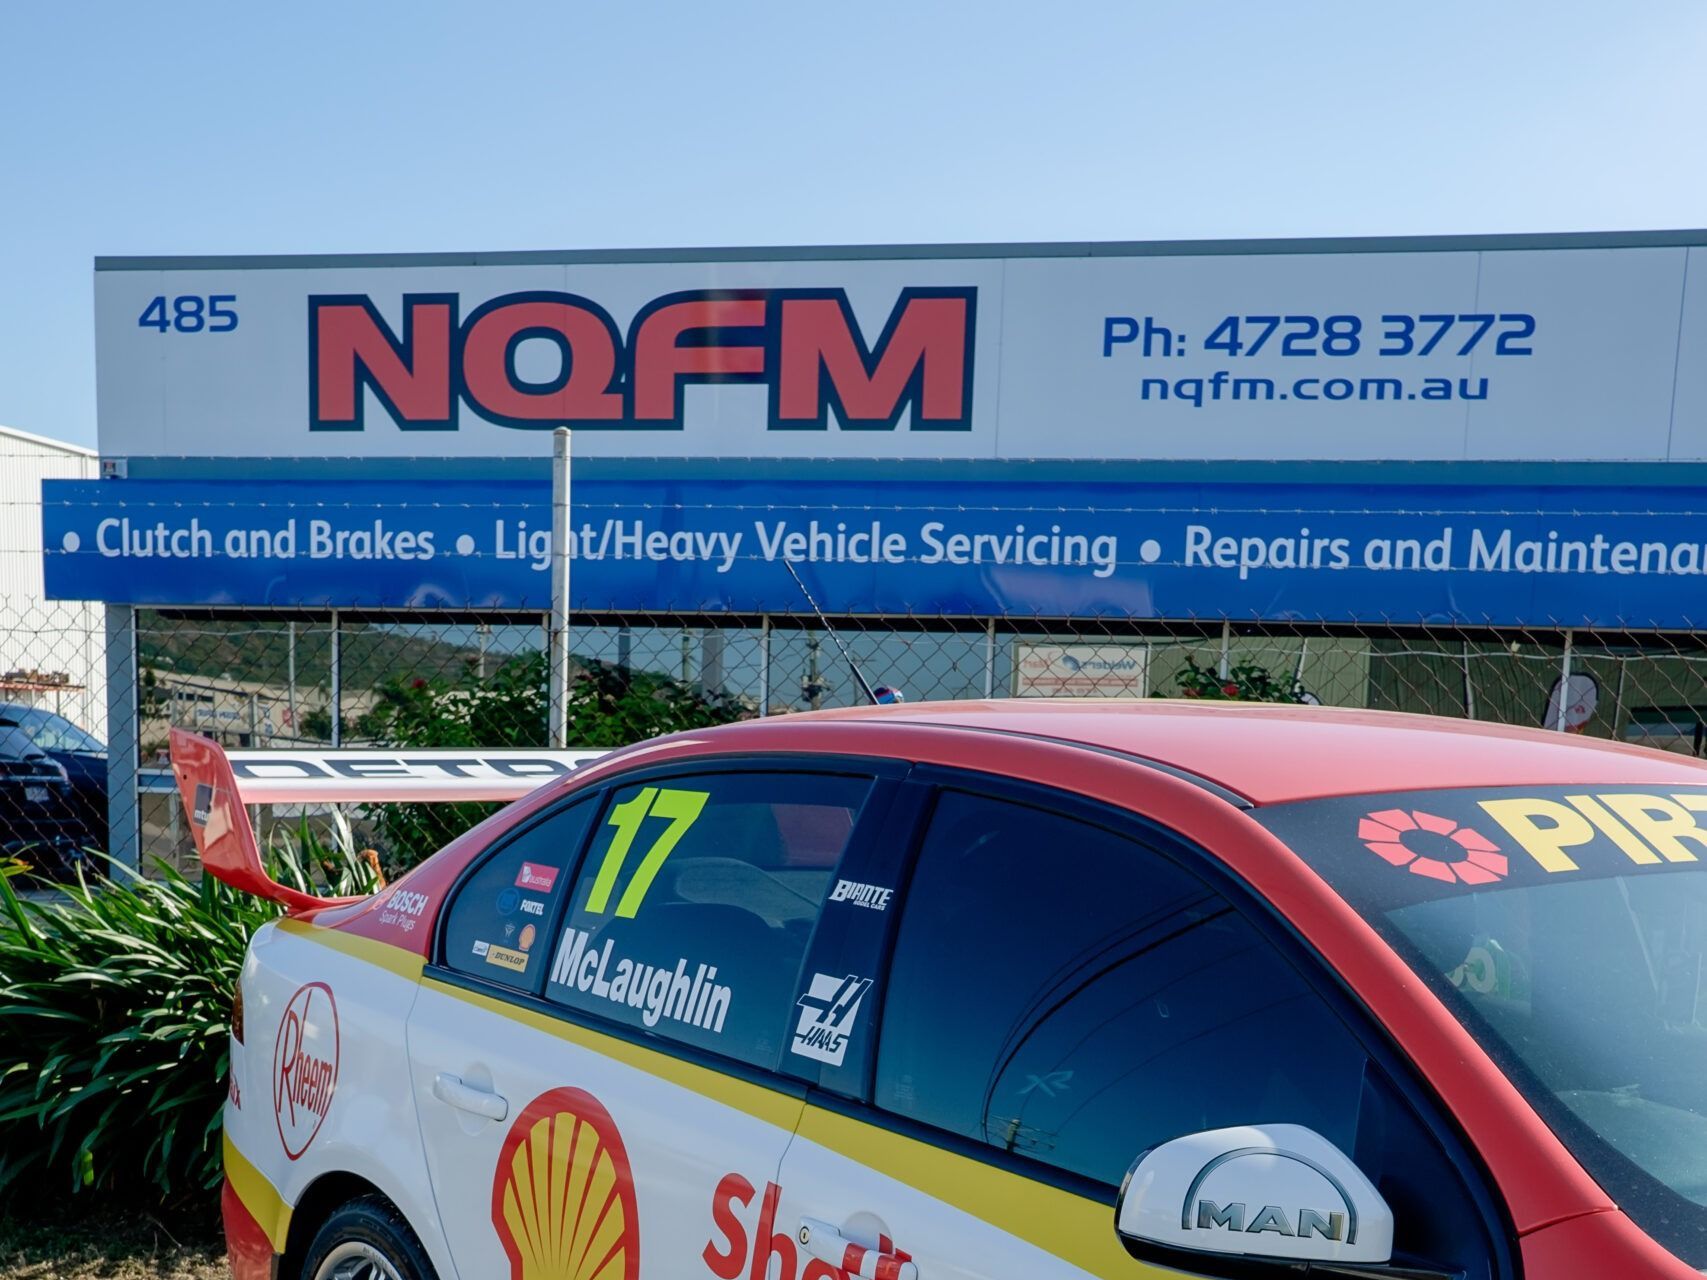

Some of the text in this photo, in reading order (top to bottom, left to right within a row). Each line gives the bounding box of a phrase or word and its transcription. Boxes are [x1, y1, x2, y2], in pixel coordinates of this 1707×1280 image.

[138, 295, 239, 333] 485
[1103, 313, 1537, 357] Ph: 4728 3772
[308, 286, 978, 431] NQFM
[1141, 371, 1489, 408] nqfm.com.au
[96, 518, 435, 561] Clutch and Brakes
[755, 520, 907, 563] Vehicle
[921, 522, 1118, 577] Servicing
[1185, 524, 1707, 579] Repairs and Maintena
[585, 787, 711, 919] 17
[387, 890, 429, 916] BOSCH
[520, 899, 545, 916] FOXTEL
[829, 879, 894, 906] BIANTE
[493, 951, 526, 966] DUNLOP
[551, 928, 732, 1034] McLaughlin
[277, 988, 333, 1128] Rheem
[796, 1026, 850, 1053] HAAS
[1196, 1200, 1345, 1242] MAN
